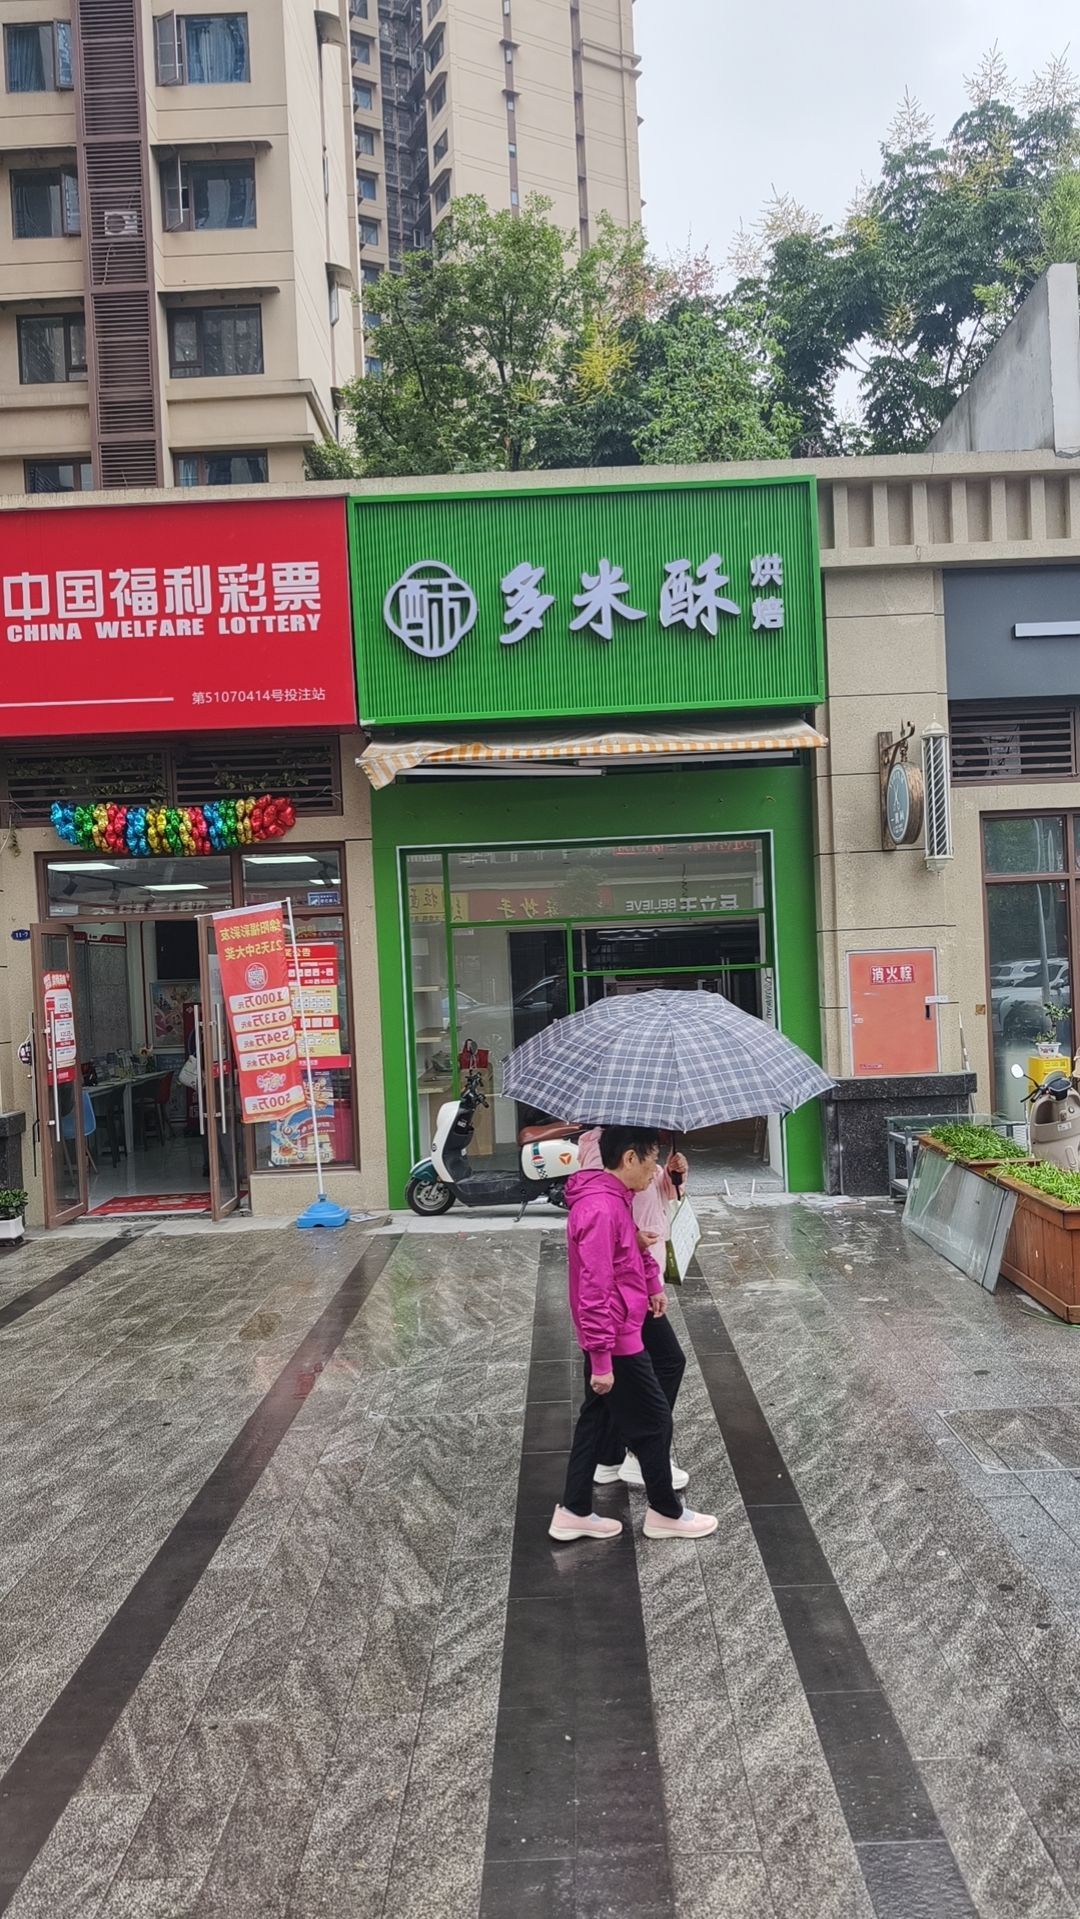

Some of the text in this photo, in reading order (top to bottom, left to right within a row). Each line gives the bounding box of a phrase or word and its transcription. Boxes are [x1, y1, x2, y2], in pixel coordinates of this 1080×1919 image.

[3, 561, 321, 620] 中国福利彩票
[499, 553, 741, 644] 多米酥
[750, 553, 785, 631] 烘焙
[7, 613, 321, 643] CHINA WELFARE LOTTERY
[191, 687, 326, 705] 第51070414号投注站
[872, 966, 912, 981] 消火栓
